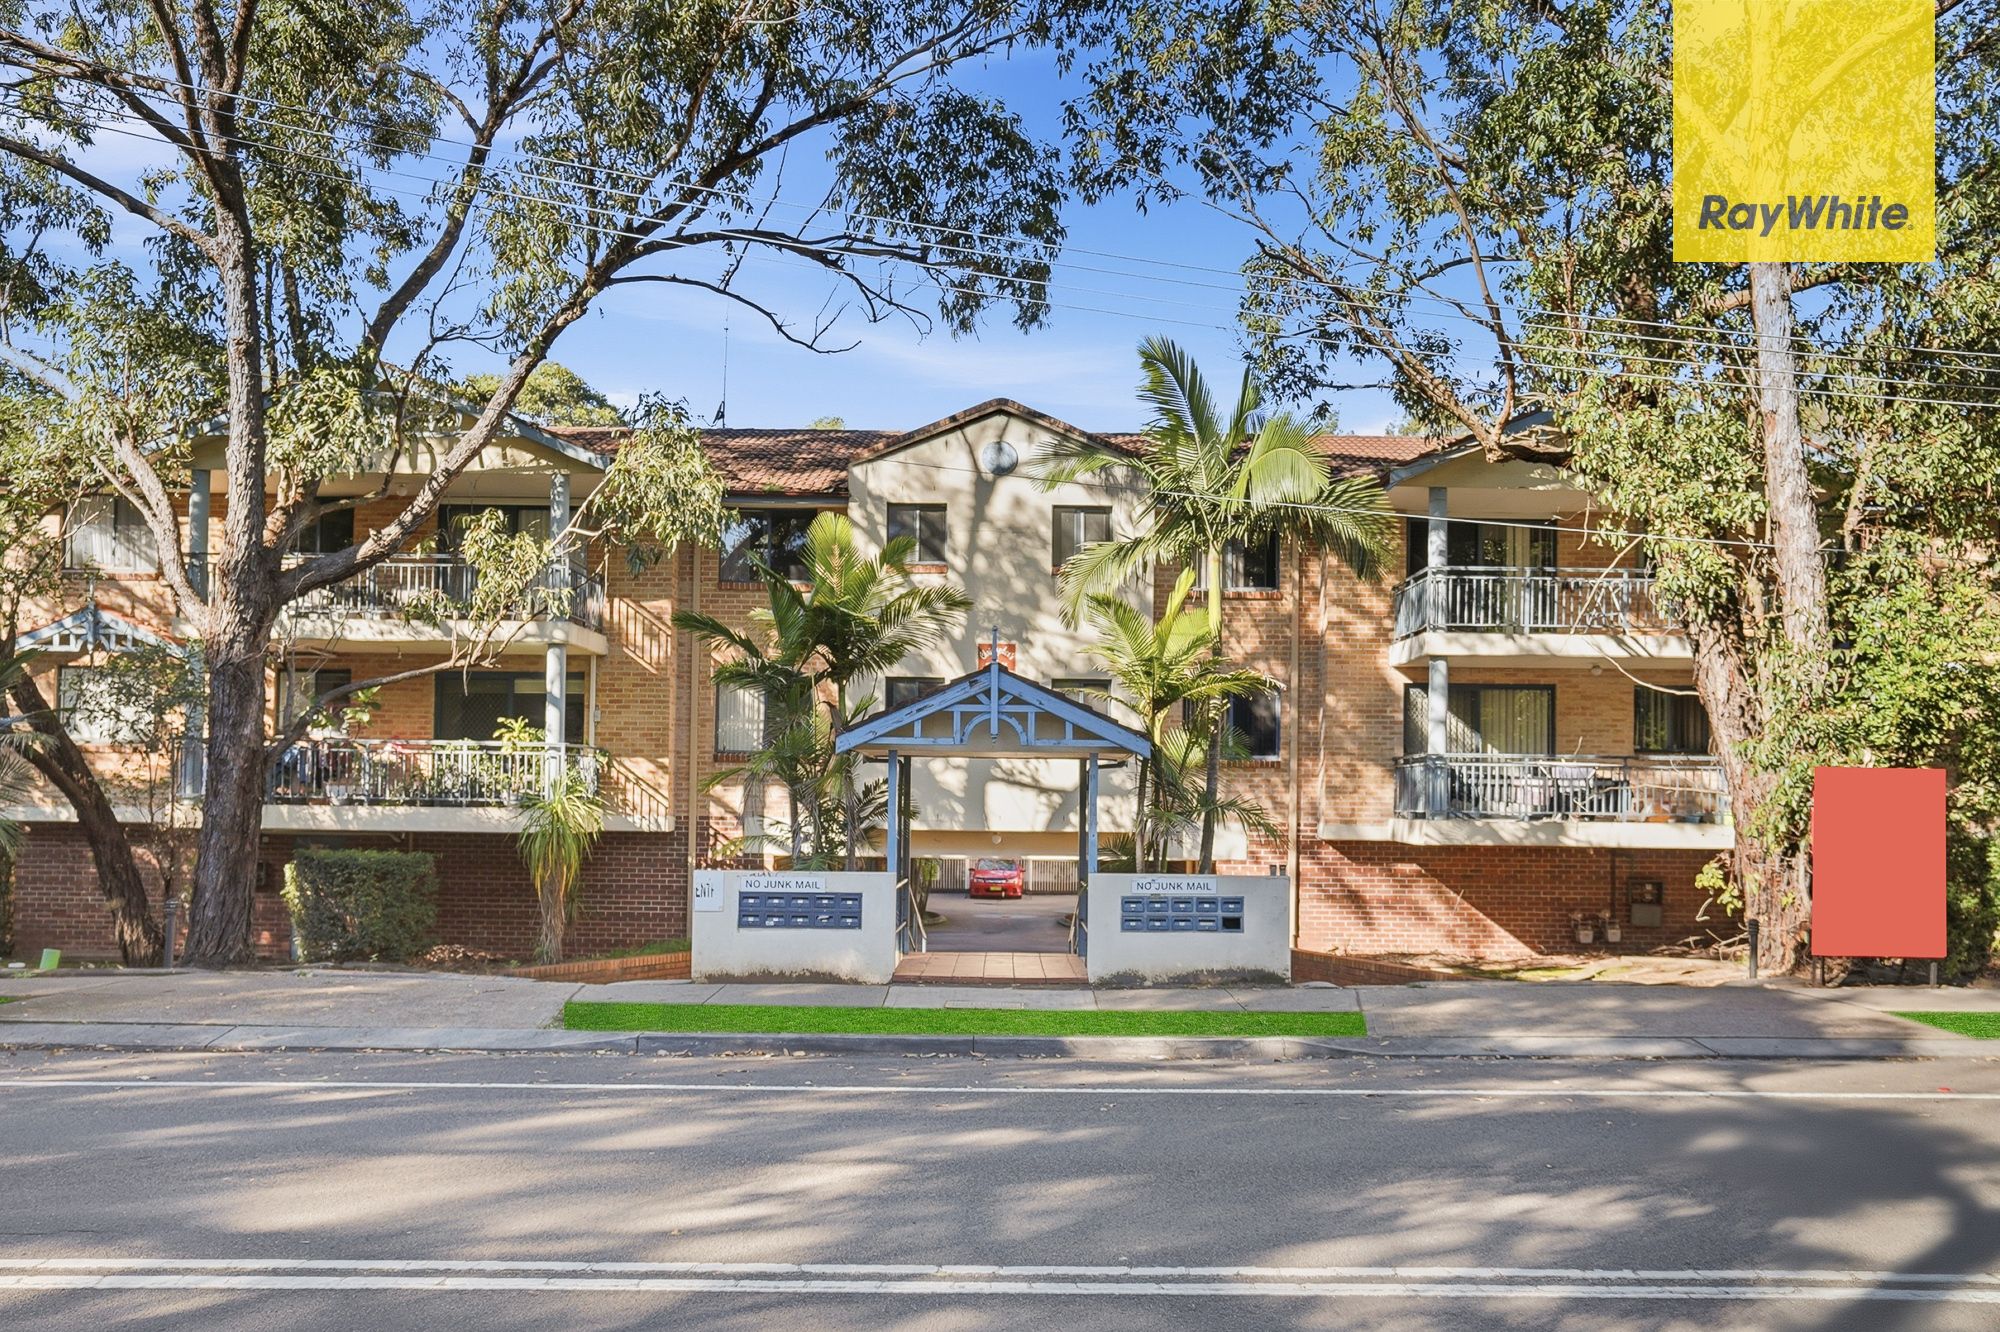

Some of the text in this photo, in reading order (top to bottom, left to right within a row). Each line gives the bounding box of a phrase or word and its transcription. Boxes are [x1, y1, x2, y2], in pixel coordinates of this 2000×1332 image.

[745, 880, 821, 889] NO JUNK MAIL
[1136, 881, 1212, 891] NO JUNK MAIL
